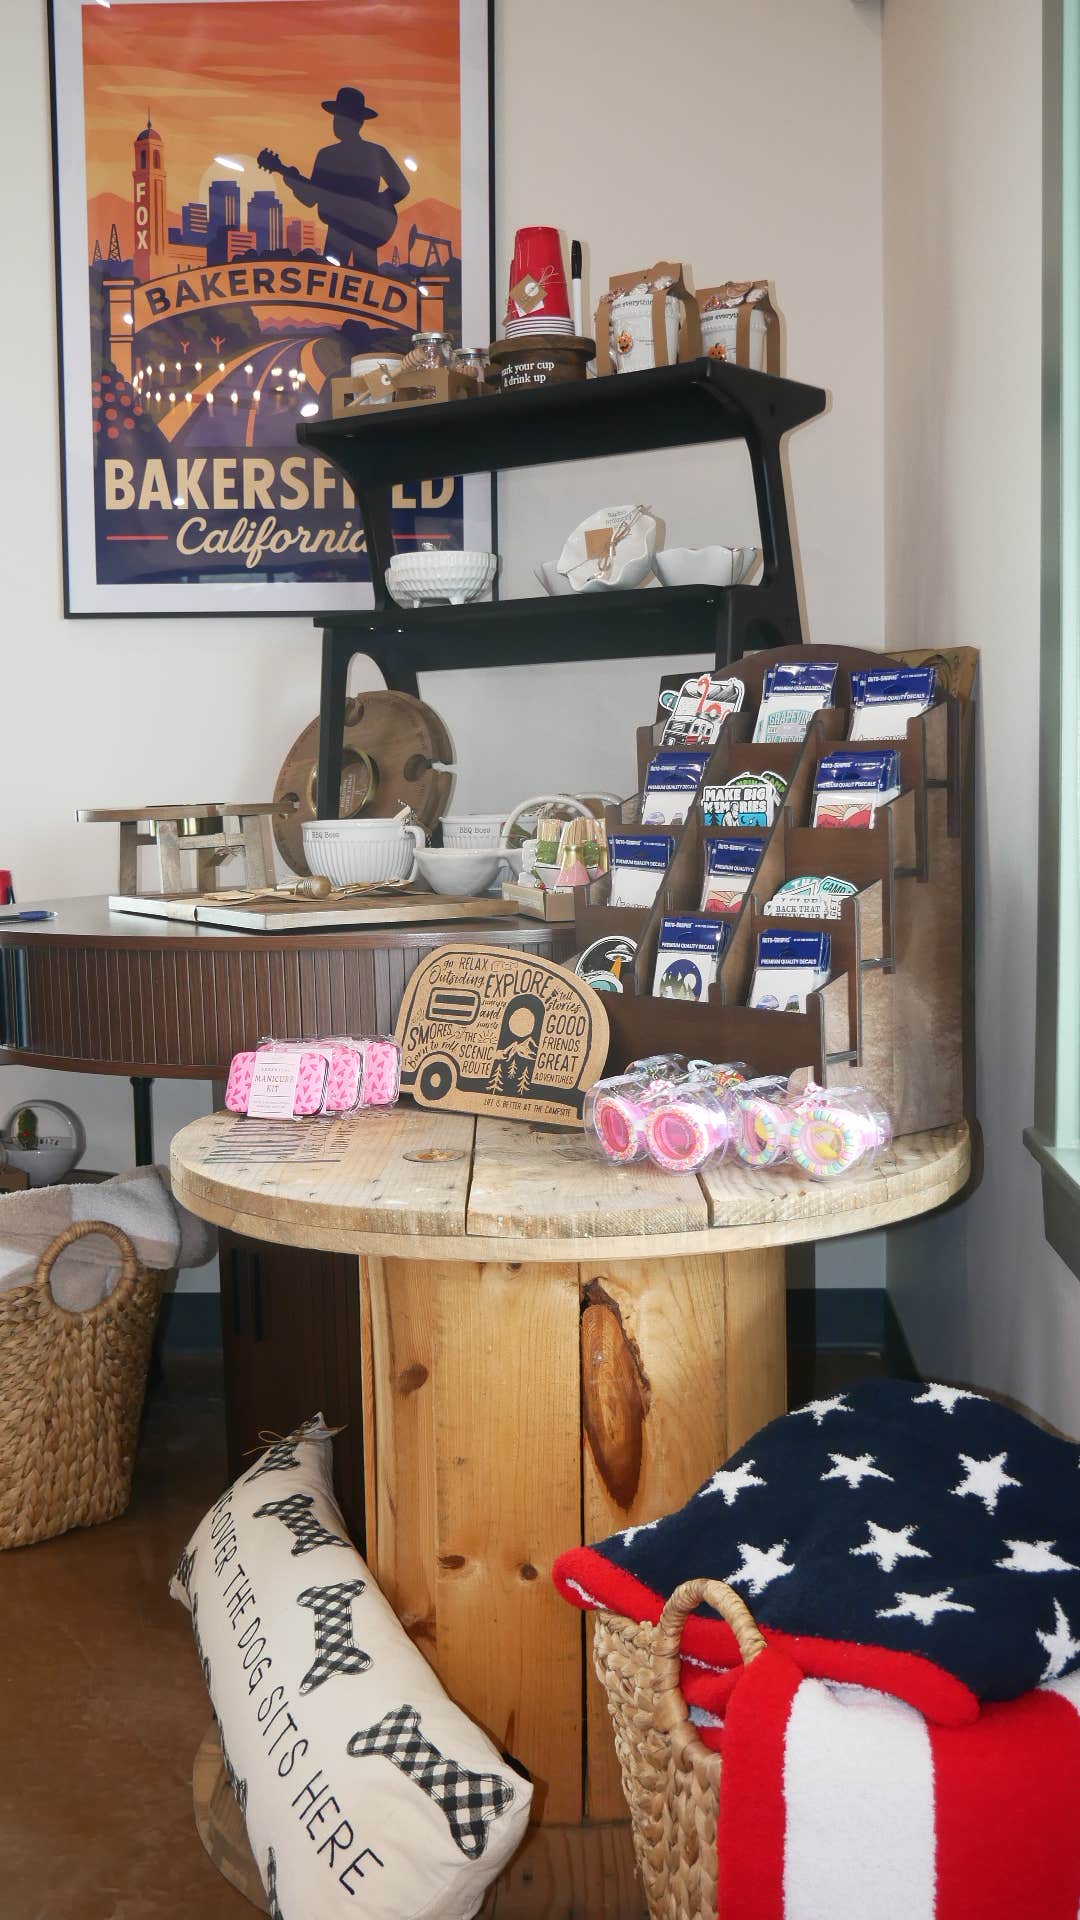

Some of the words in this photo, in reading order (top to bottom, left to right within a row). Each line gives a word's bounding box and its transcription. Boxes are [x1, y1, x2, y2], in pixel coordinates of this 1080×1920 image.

[135, 182, 149, 250] FOX
[144, 267, 409, 316] BAKERSFIELD
[514, 361, 535, 375] your
[537, 360, 555, 372] cup
[509, 373, 532, 386] drink
[533, 373, 547, 384] up
[175, 515, 368, 569] California
[768, 710, 813, 725] GRAPEVIN
[705, 787, 741, 802] MAKE
[743, 787, 767, 802] BIG
[459, 826, 473, 834] BBQ
[822, 881, 846, 894] CAMP
[776, 905, 797, 913] BACK
[799, 905, 821, 913] THAT
[661, 941, 680, 949] PREMIUM
[443, 960, 454, 970] go
[458, 956, 489, 972] RELAX
[760, 958, 781, 966] PREMIUM
[781, 958, 799, 966] QUALITY
[799, 958, 817, 966] DECALS
[484, 968, 554, 999] EXPLORE
[559, 990, 574, 1001] tell
[479, 1007, 502, 1020] and
[545, 1014, 587, 1037] GOOD
[464, 1031, 478, 1042] THE
[404, 1045, 428, 1070] Born
[430, 1040, 439, 1051] to
[441, 1040, 460, 1053] roll
[459, 1044, 494, 1061] SCENIC
[461, 1060, 491, 1076] ROUTE
[537, 1052, 578, 1073] GREAT
[534, 1072, 574, 1085] ADVENTURES
[266, 1085, 279, 1093] KIT
[502, 1100, 521, 1109] BETTER
[522, 1103, 532, 1111] AT
[533, 1104, 544, 1113] THE
[544, 1105, 571, 1117] CAMPSITE
[210, 1511, 238, 1577] OVER
[222, 1563, 257, 1631] THE
[236, 1616, 272, 1696] DOG
[257, 1685, 309, 1778] SITS
[291, 1769, 385, 1896] HERE
